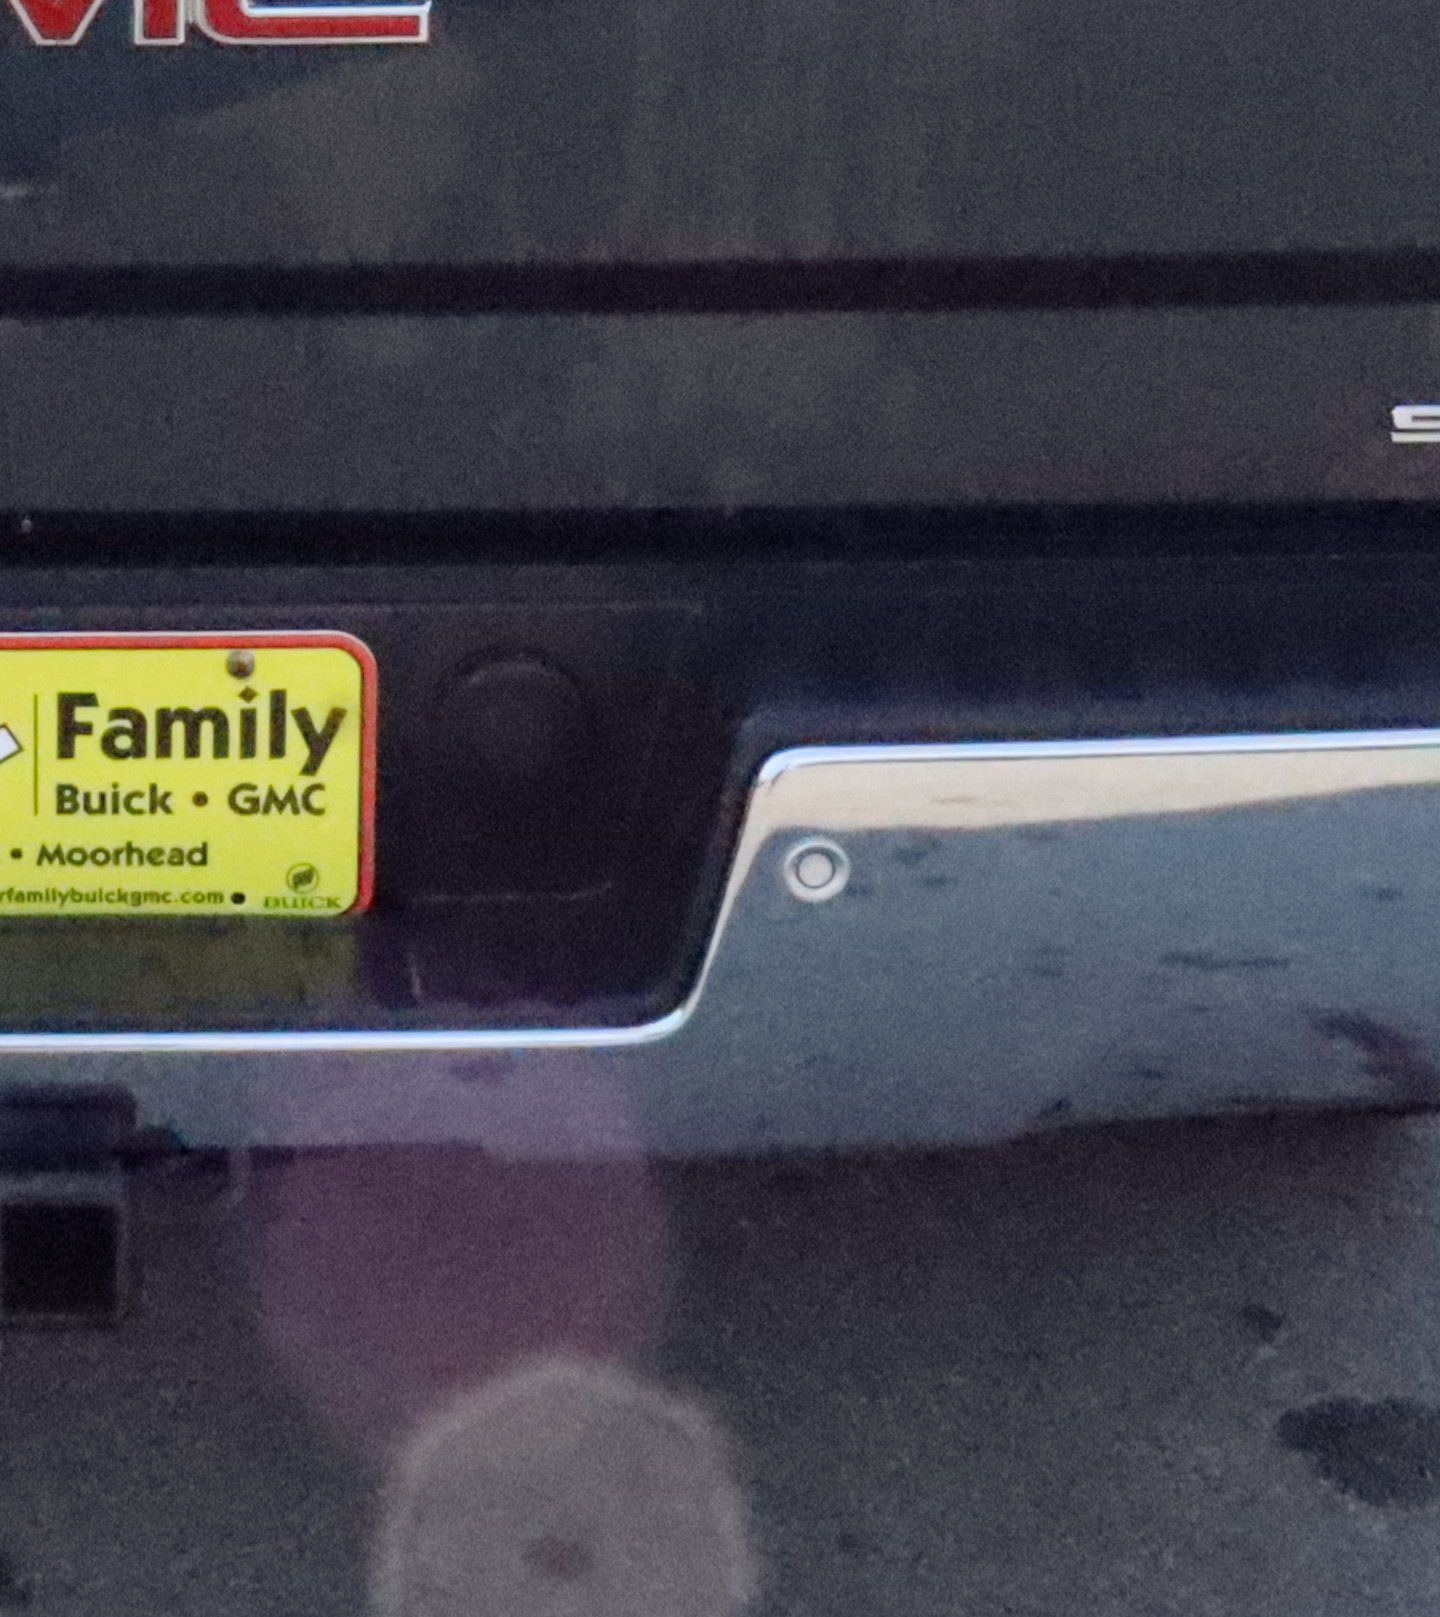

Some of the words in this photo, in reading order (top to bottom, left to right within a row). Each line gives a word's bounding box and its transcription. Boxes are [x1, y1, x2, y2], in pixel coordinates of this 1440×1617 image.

[56, 689, 347, 776] Family
[56, 783, 172, 816] Buick
[228, 784, 325, 816] GMC
[37, 841, 208, 868] Moorhead
[264, 895, 342, 909] BUICK
